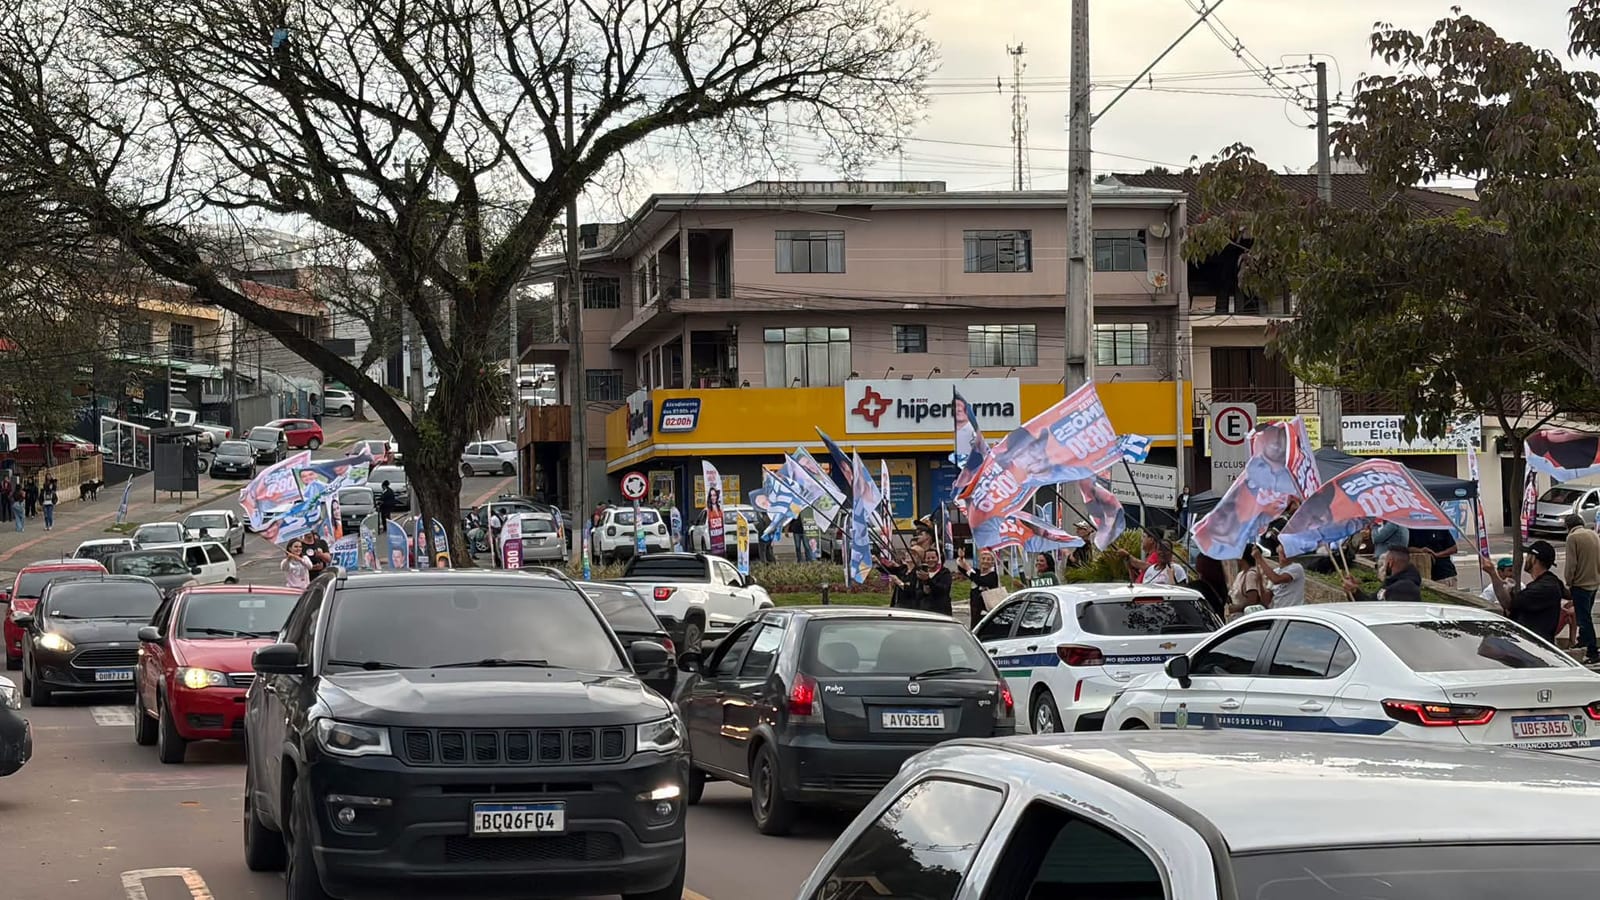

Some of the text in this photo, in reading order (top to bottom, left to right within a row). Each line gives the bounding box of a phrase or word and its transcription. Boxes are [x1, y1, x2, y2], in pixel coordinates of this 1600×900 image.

[666, 417, 691, 426] 02:00h
[1227, 415, 1240, 436] E
[1342, 417, 1403, 429] omercial
[1214, 461, 1246, 469] EXCLUSI
[1131, 470, 1164, 481] Delegacia
[1136, 491, 1165, 500] unicipal
[890, 714, 939, 727] AYQ3E10
[1219, 717, 1239, 725] RANCO
[1251, 718, 1263, 726] SUL
[1520, 722, 1567, 735] UBF3A56
[482, 812, 554, 829] BCQ6F04
